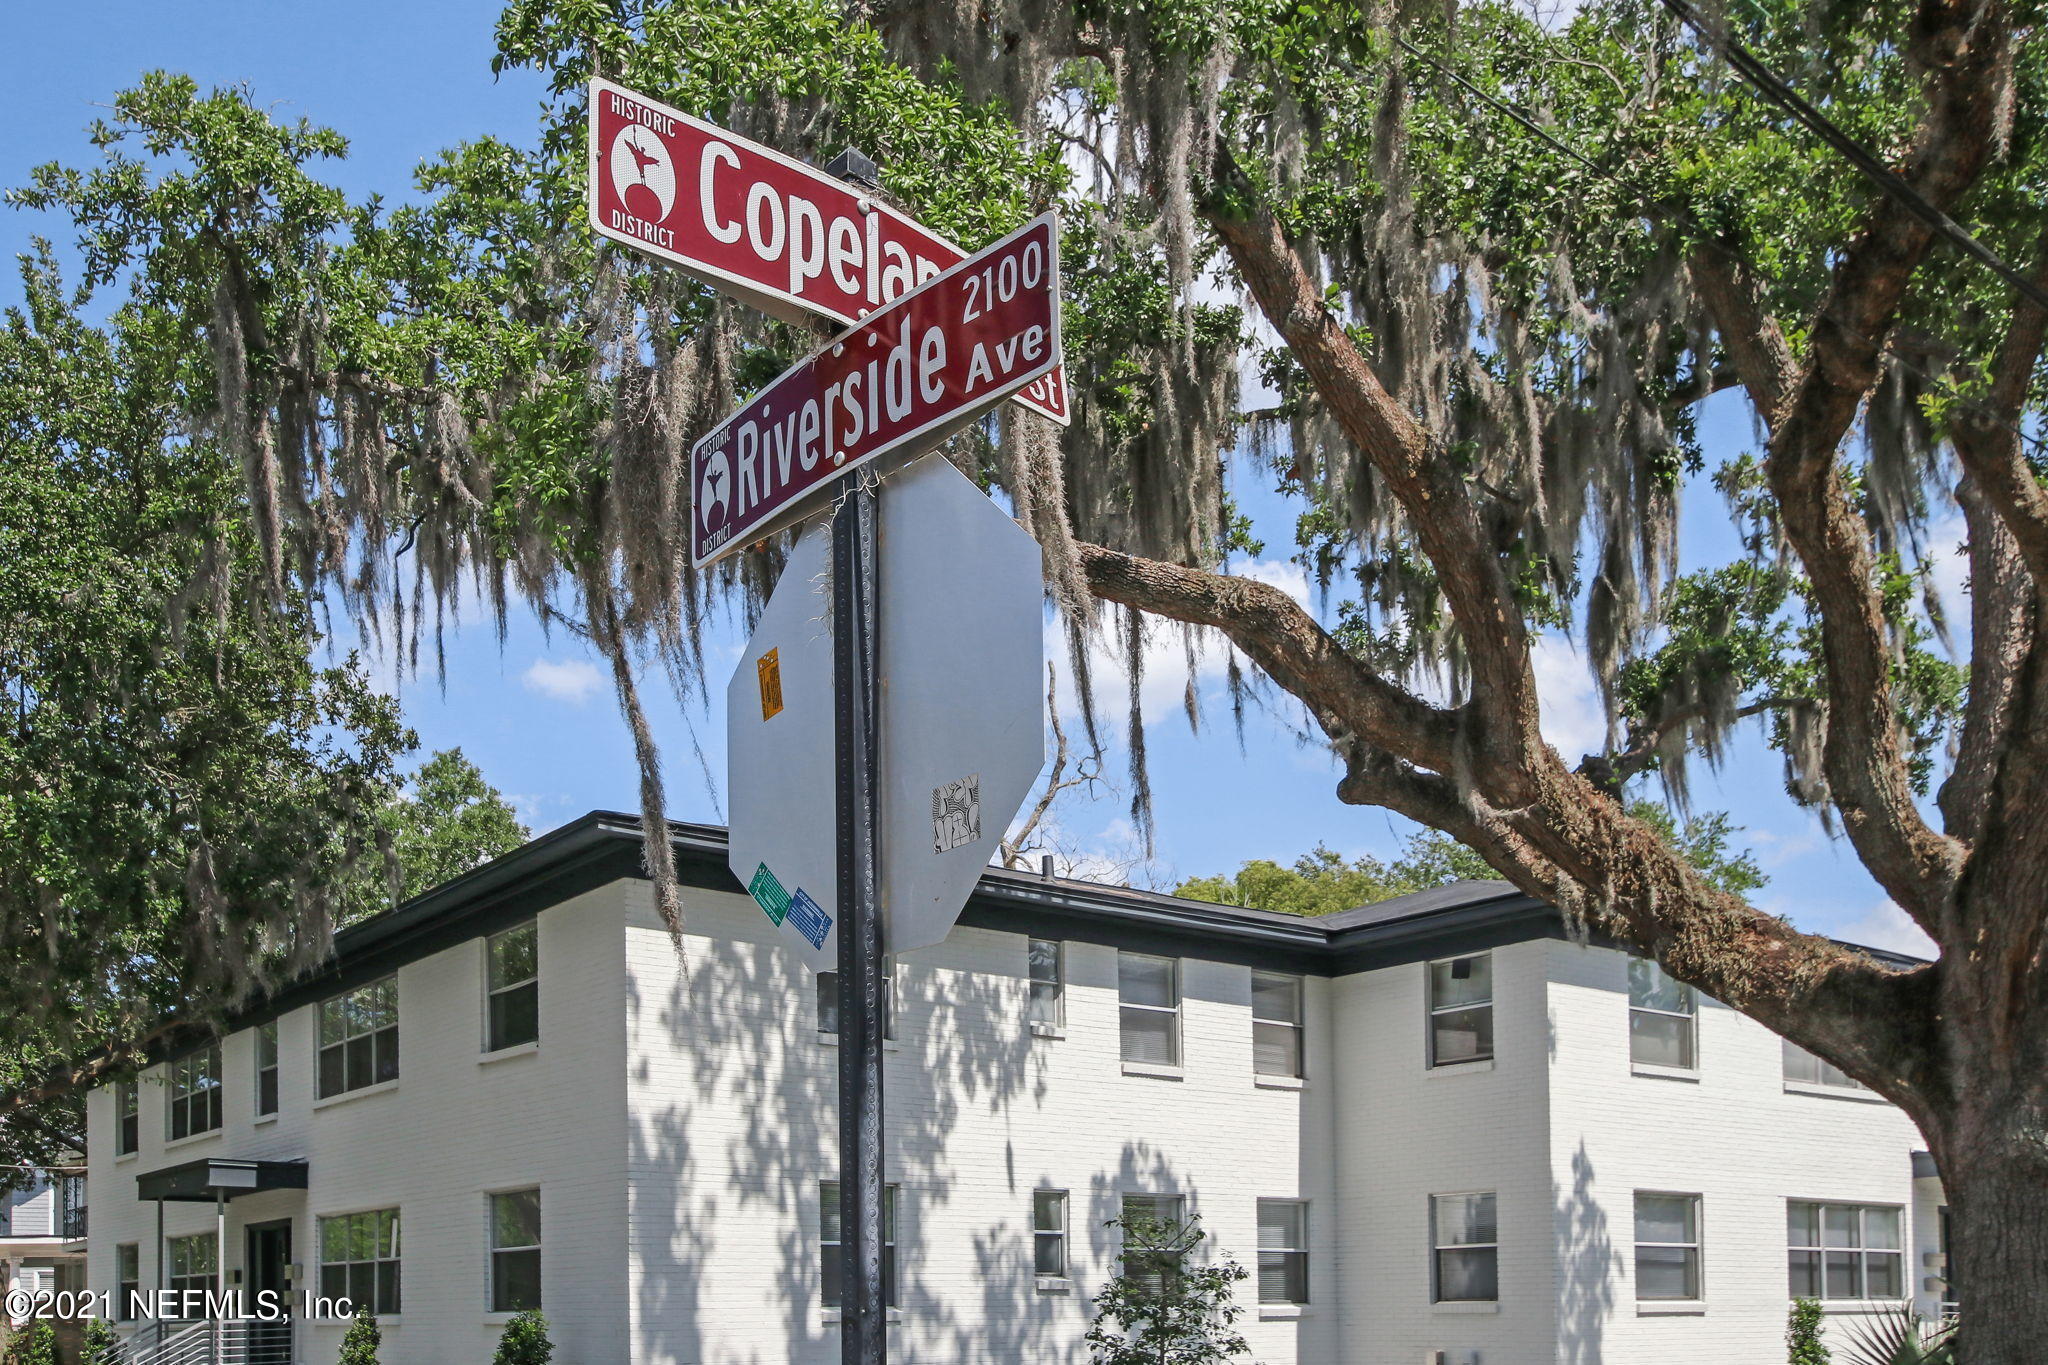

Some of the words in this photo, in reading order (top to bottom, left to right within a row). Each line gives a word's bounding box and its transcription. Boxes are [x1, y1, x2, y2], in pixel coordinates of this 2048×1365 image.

[611, 93, 676, 138] HISTORIC
[612, 208, 675, 249] DISTRICT
[962, 240, 1042, 325] 2100
[737, 312, 947, 518] Riverside
[964, 324, 1044, 394] Ave
[701, 425, 731, 462] HISTORIC
[702, 522, 732, 556] DISTRICT
